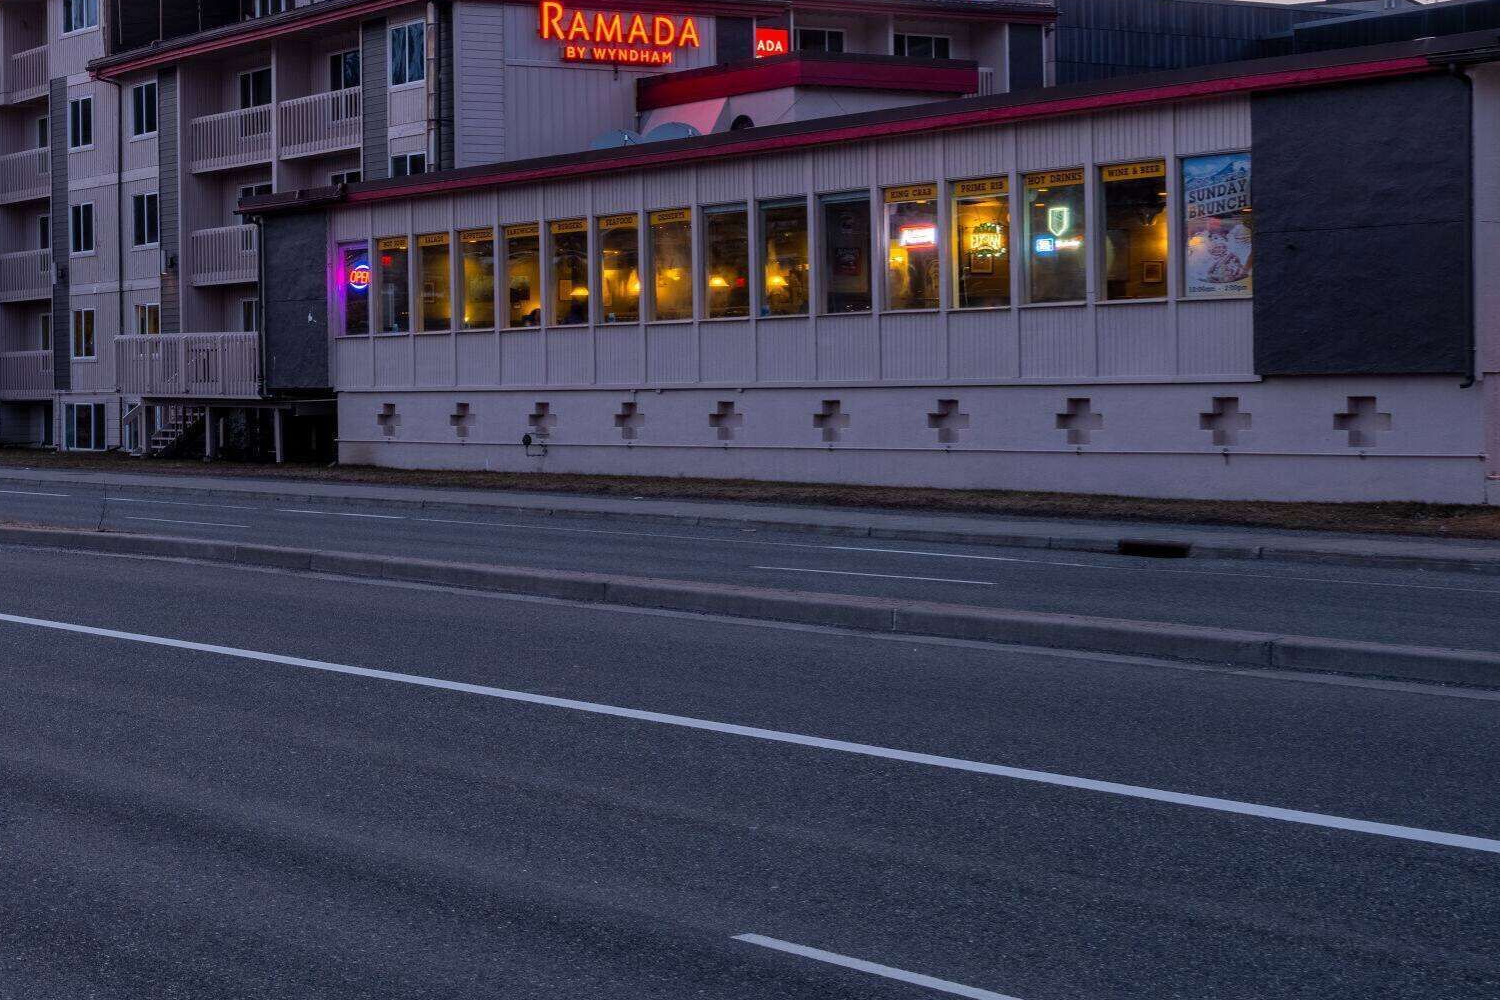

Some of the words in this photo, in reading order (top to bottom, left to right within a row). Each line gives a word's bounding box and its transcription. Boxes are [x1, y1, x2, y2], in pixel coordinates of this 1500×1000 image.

[541, 0, 700, 48] RAMADA
[566, 47, 586, 59] BY
[593, 47, 673, 65] WYNDHAM
[1027, 175, 1045, 186] HOT
[1050, 172, 1083, 184] DRINKS
[1107, 169, 1128, 178] WINE
[1140, 164, 1161, 174] BEER
[960, 181, 986, 193] PRIME
[1188, 179, 1247, 204] SUNDAY
[1188, 194, 1248, 219] BRUNCH
[604, 215, 633, 227] SEAFOOD
